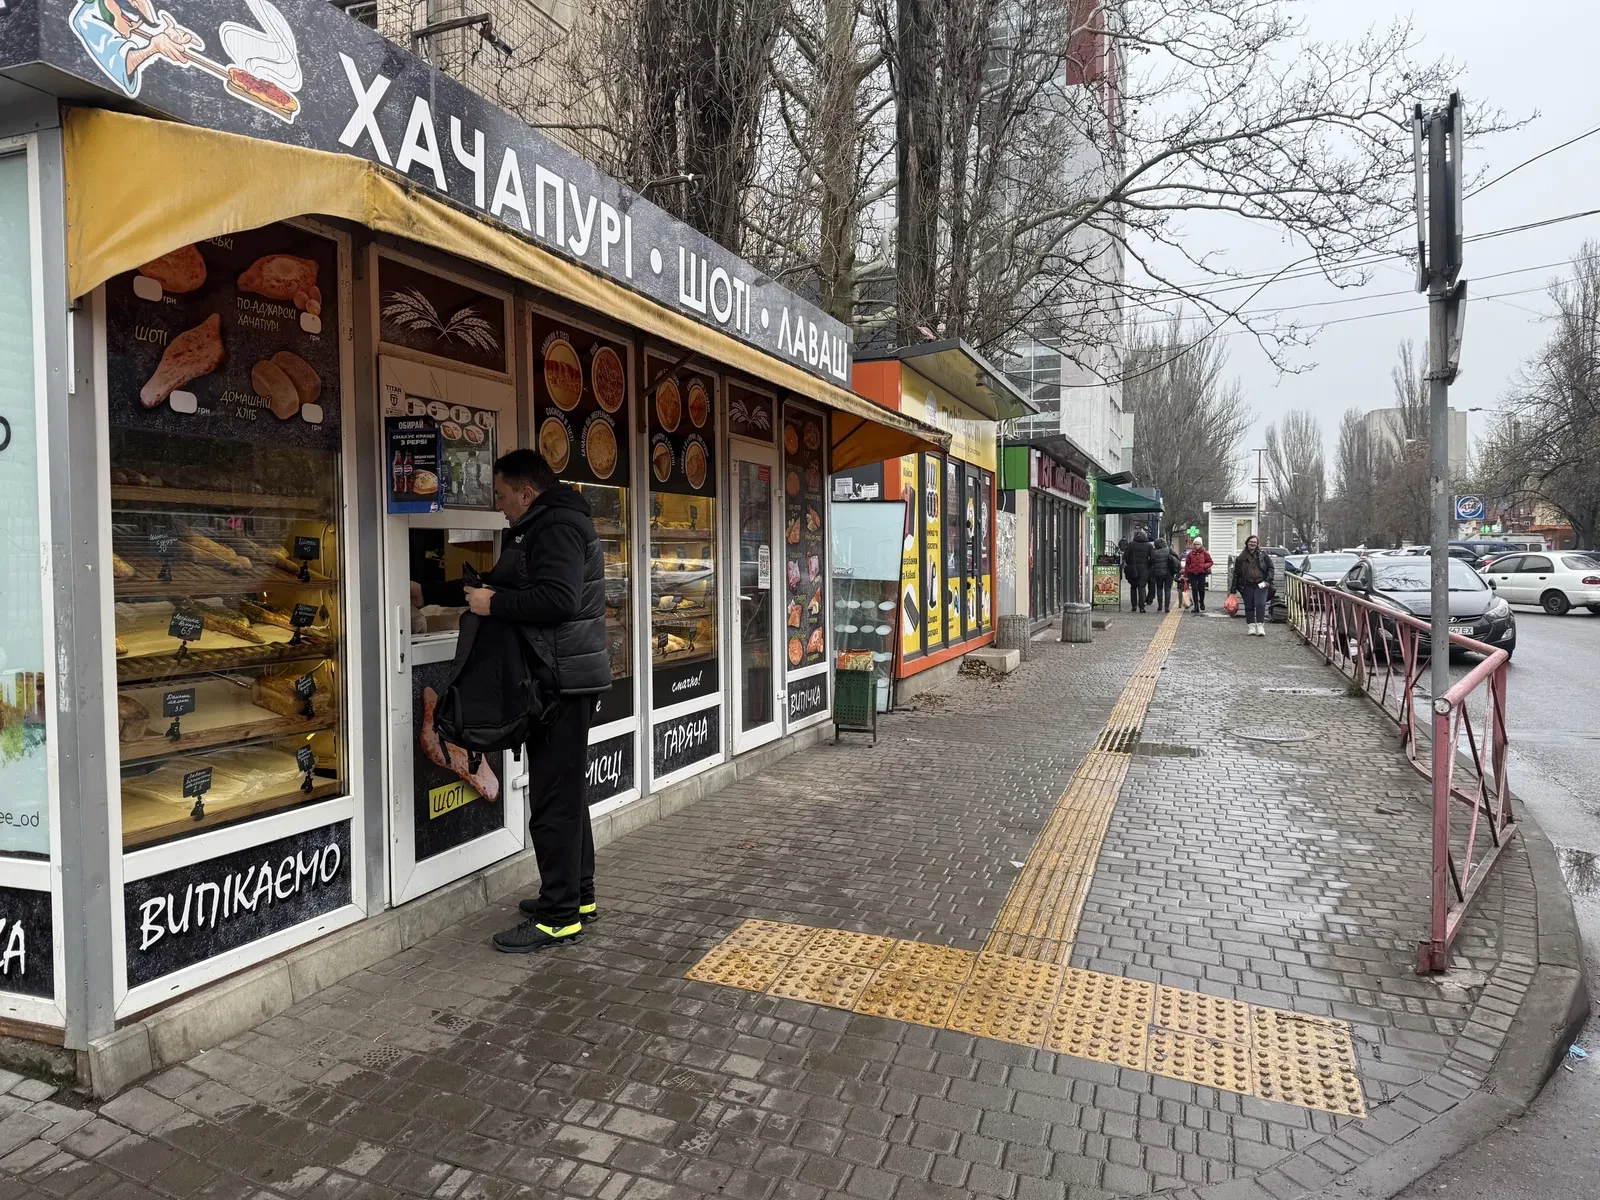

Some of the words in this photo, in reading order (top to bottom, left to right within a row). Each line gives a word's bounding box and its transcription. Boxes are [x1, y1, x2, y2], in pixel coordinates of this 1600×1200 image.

[338, 51, 633, 279] ХАЧАПУРІ
[678, 246, 751, 334] ШОТІ
[778, 306, 848, 381] ЛАВАШ
[163, 296, 177, 305] грн
[237, 312, 280, 332] ХАЧАПУРІ
[134, 324, 168, 346] ШОТІ
[385, 384, 402, 393] TITAN
[220, 390, 273, 409] ДОМАШНІЙ
[235, 405, 258, 421] ХЛІБ
[398, 419, 424, 430] ОБИРАЙ
[180, 626, 192, 636] 65
[671, 670, 703, 693] смачно!
[789, 685, 821, 716] ВИПІЧКА
[663, 715, 708, 760] ГАРЯЧА
[432, 784, 465, 813] ШОТІ
[138, 842, 341, 951] ВИПІКАЄМО
